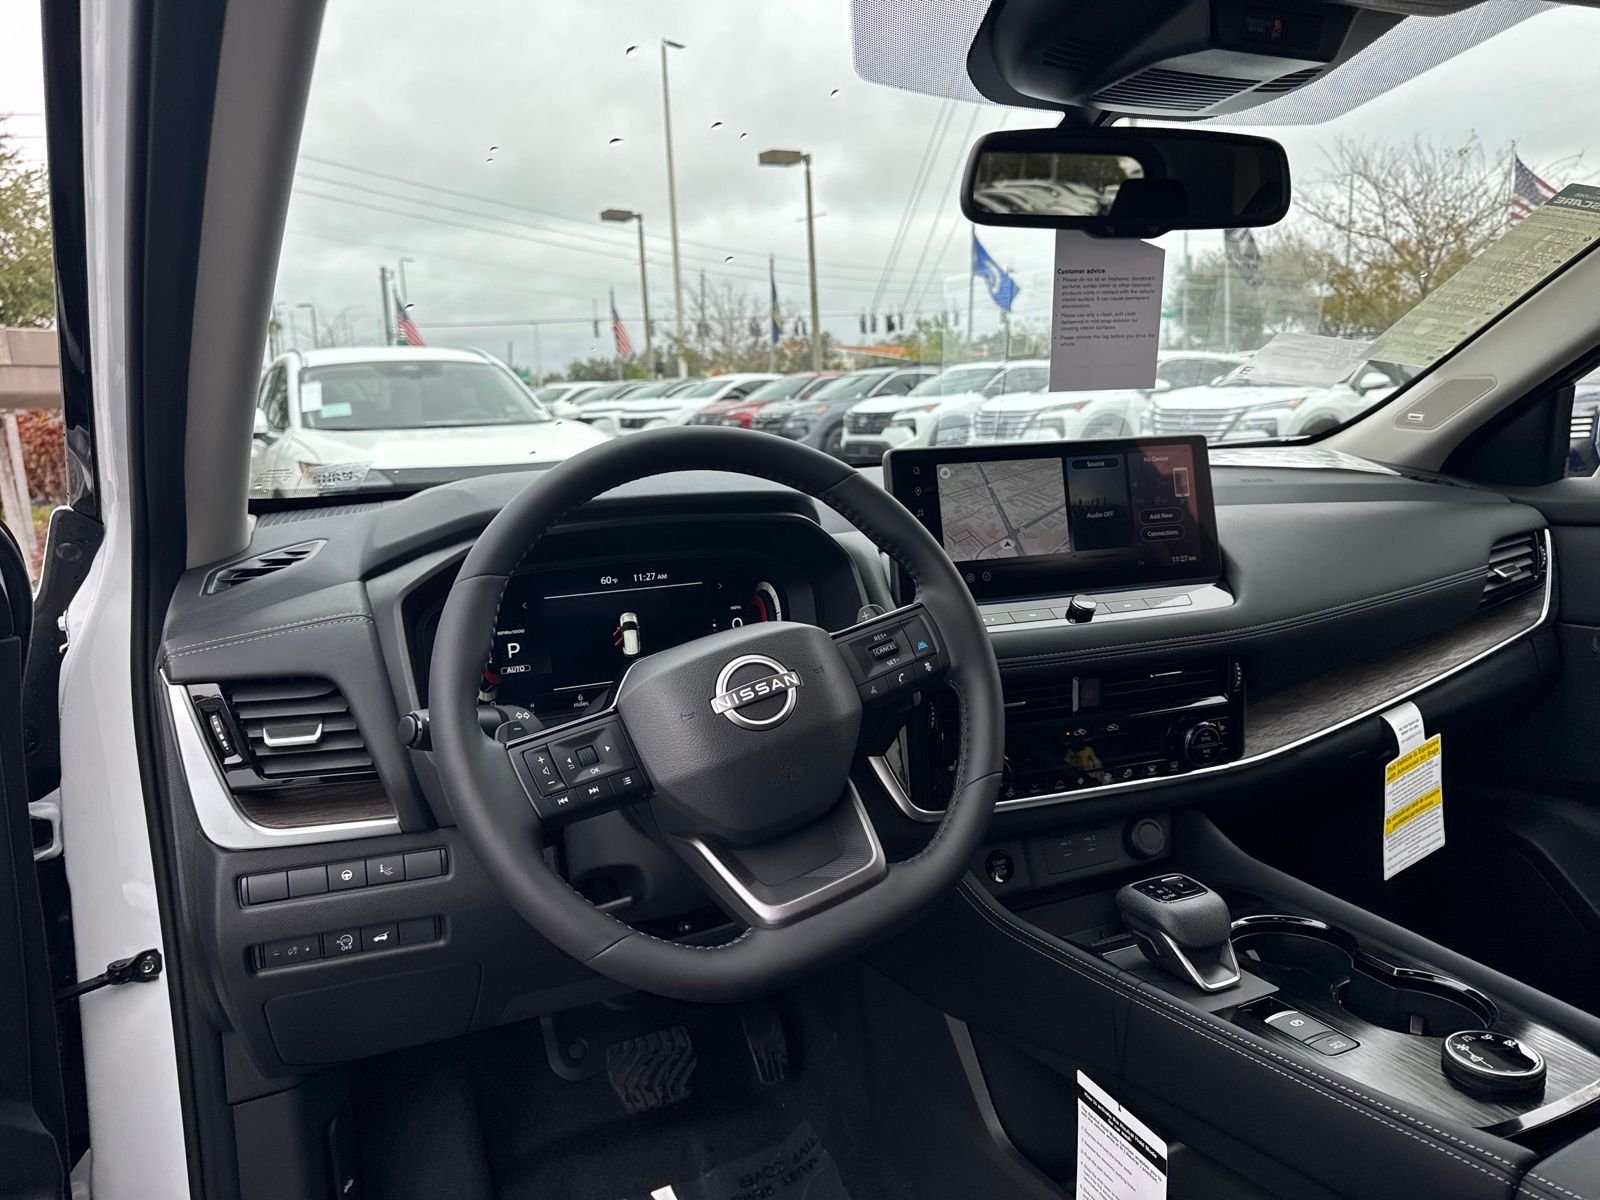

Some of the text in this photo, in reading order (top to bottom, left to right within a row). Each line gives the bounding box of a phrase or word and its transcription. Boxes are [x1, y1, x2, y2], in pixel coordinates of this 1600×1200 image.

[1086, 460, 1105, 468] Source
[1086, 510, 1115, 519] Audio OFF
[1149, 511, 1174, 520] Add New
[1147, 529, 1179, 538] Connections
[1172, 554, 1188, 563] 11:27
[633, 573, 656, 582] 11:27
[507, 642, 521, 659] P
[875, 643, 896, 654] CANCEL
[716, 673, 799, 712] NISSAN
[573, 700, 590, 709] miles
[590, 767, 601, 775] OK
